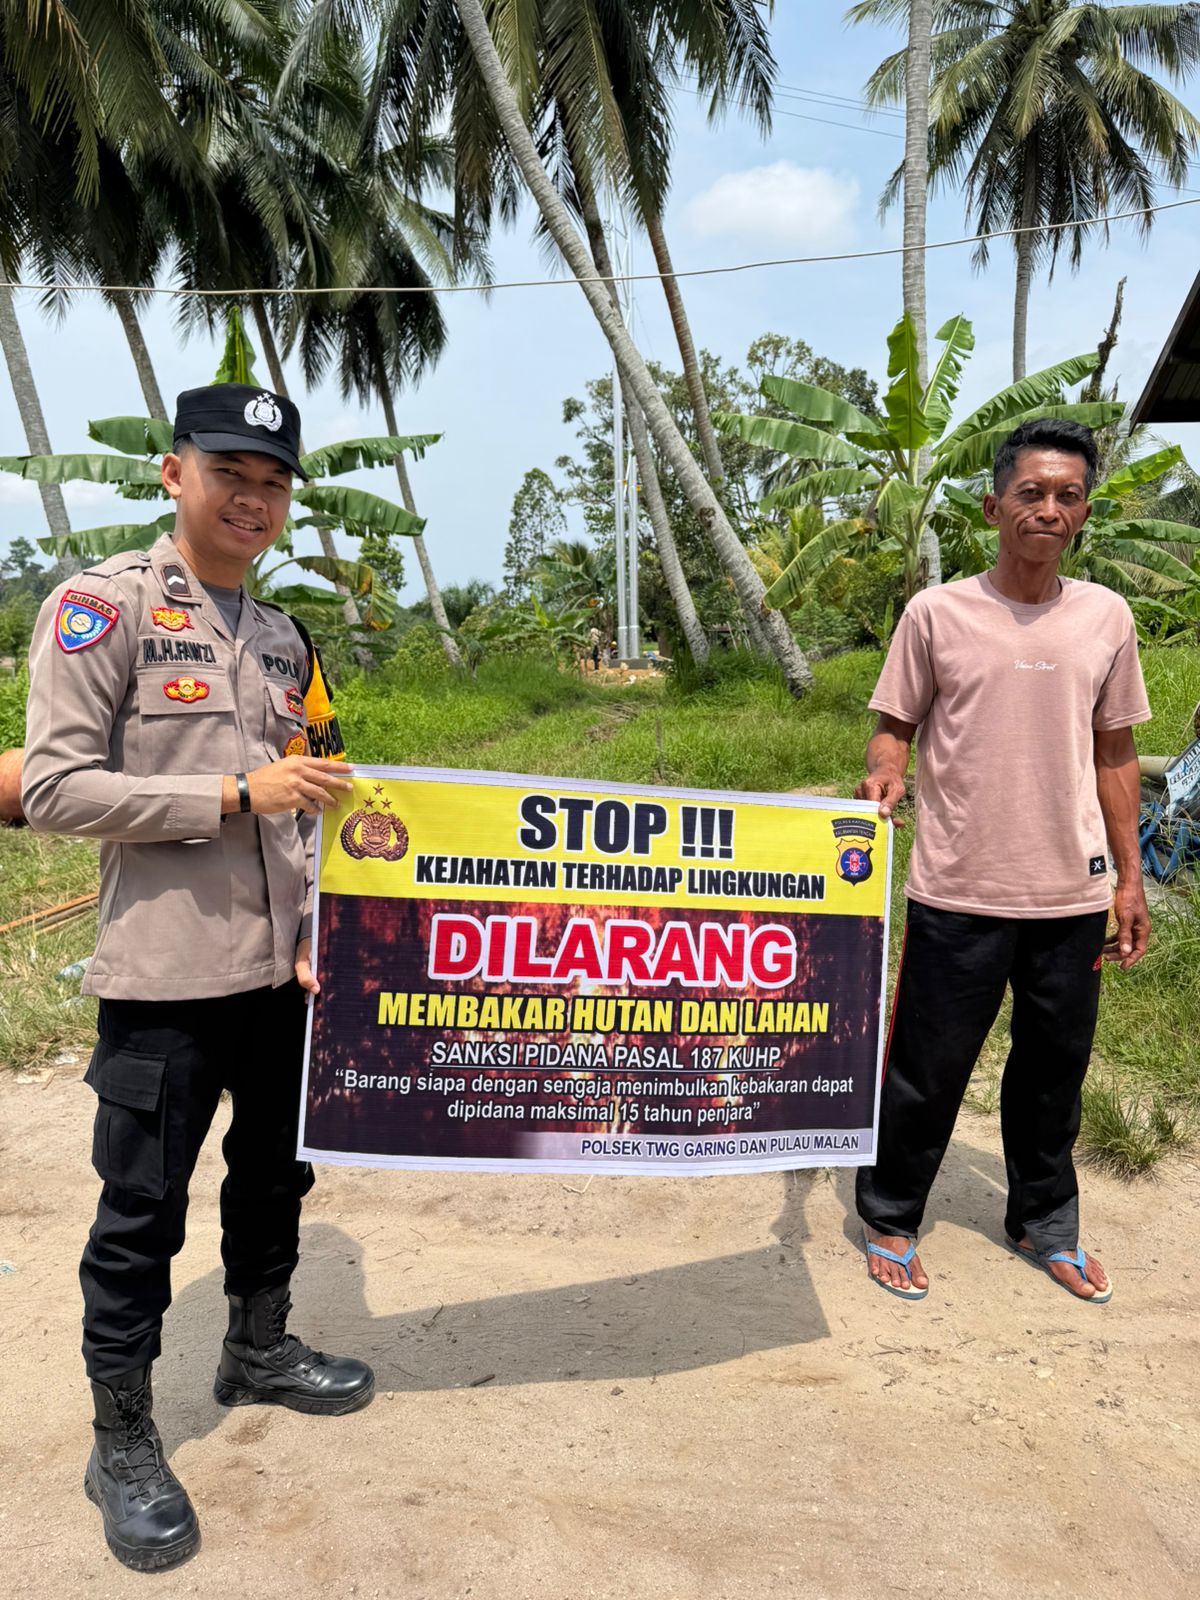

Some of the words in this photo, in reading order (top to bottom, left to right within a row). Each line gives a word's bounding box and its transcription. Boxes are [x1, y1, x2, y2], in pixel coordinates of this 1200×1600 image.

[143, 638, 217, 664] M.H.FAWZI
[519, 794, 668, 856] STOP
[680, 805, 735, 860] !!!
[415, 854, 557, 888] KEJAHATAN
[562, 862, 683, 893] TERHADAP
[687, 868, 825, 900] LINGKUNGAN
[430, 915, 795, 987] DILARANG
[377, 992, 565, 1030] MEMBAKAR
[572, 998, 673, 1033] HUTAN
[680, 1000, 737, 1033] DAN
[743, 1001, 829, 1033] LAHAN
[431, 1041, 518, 1065] SANKSI
[524, 1044, 608, 1067] PIDANA
[614, 1046, 684, 1068] PASAL
[690, 1047, 723, 1068] 187
[728, 1046, 781, 1068] KUHP
[335, 1068, 411, 1095] “Barang
[416, 1072, 466, 1096] siapa
[471, 1074, 538, 1097] dengan
[543, 1076, 611, 1099] sengaja
[616, 1077, 728, 1097] menimbulkan
[731, 1075, 808, 1096] kebakaran
[811, 1075, 854, 1097] dapat
[447, 1100, 525, 1122] dipidana
[530, 1101, 614, 1121] maksimal
[620, 1103, 639, 1121] 15
[644, 1104, 692, 1122] tahun
[697, 1101, 761, 1127] penjara”
[581, 1139, 642, 1156] POLSEK
[646, 1141, 680, 1157] TWG
[683, 1140, 736, 1157] GARING
[740, 1138, 768, 1155] DAN
[770, 1136, 810, 1152] PULAU
[813, 1135, 859, 1150] MALAN
